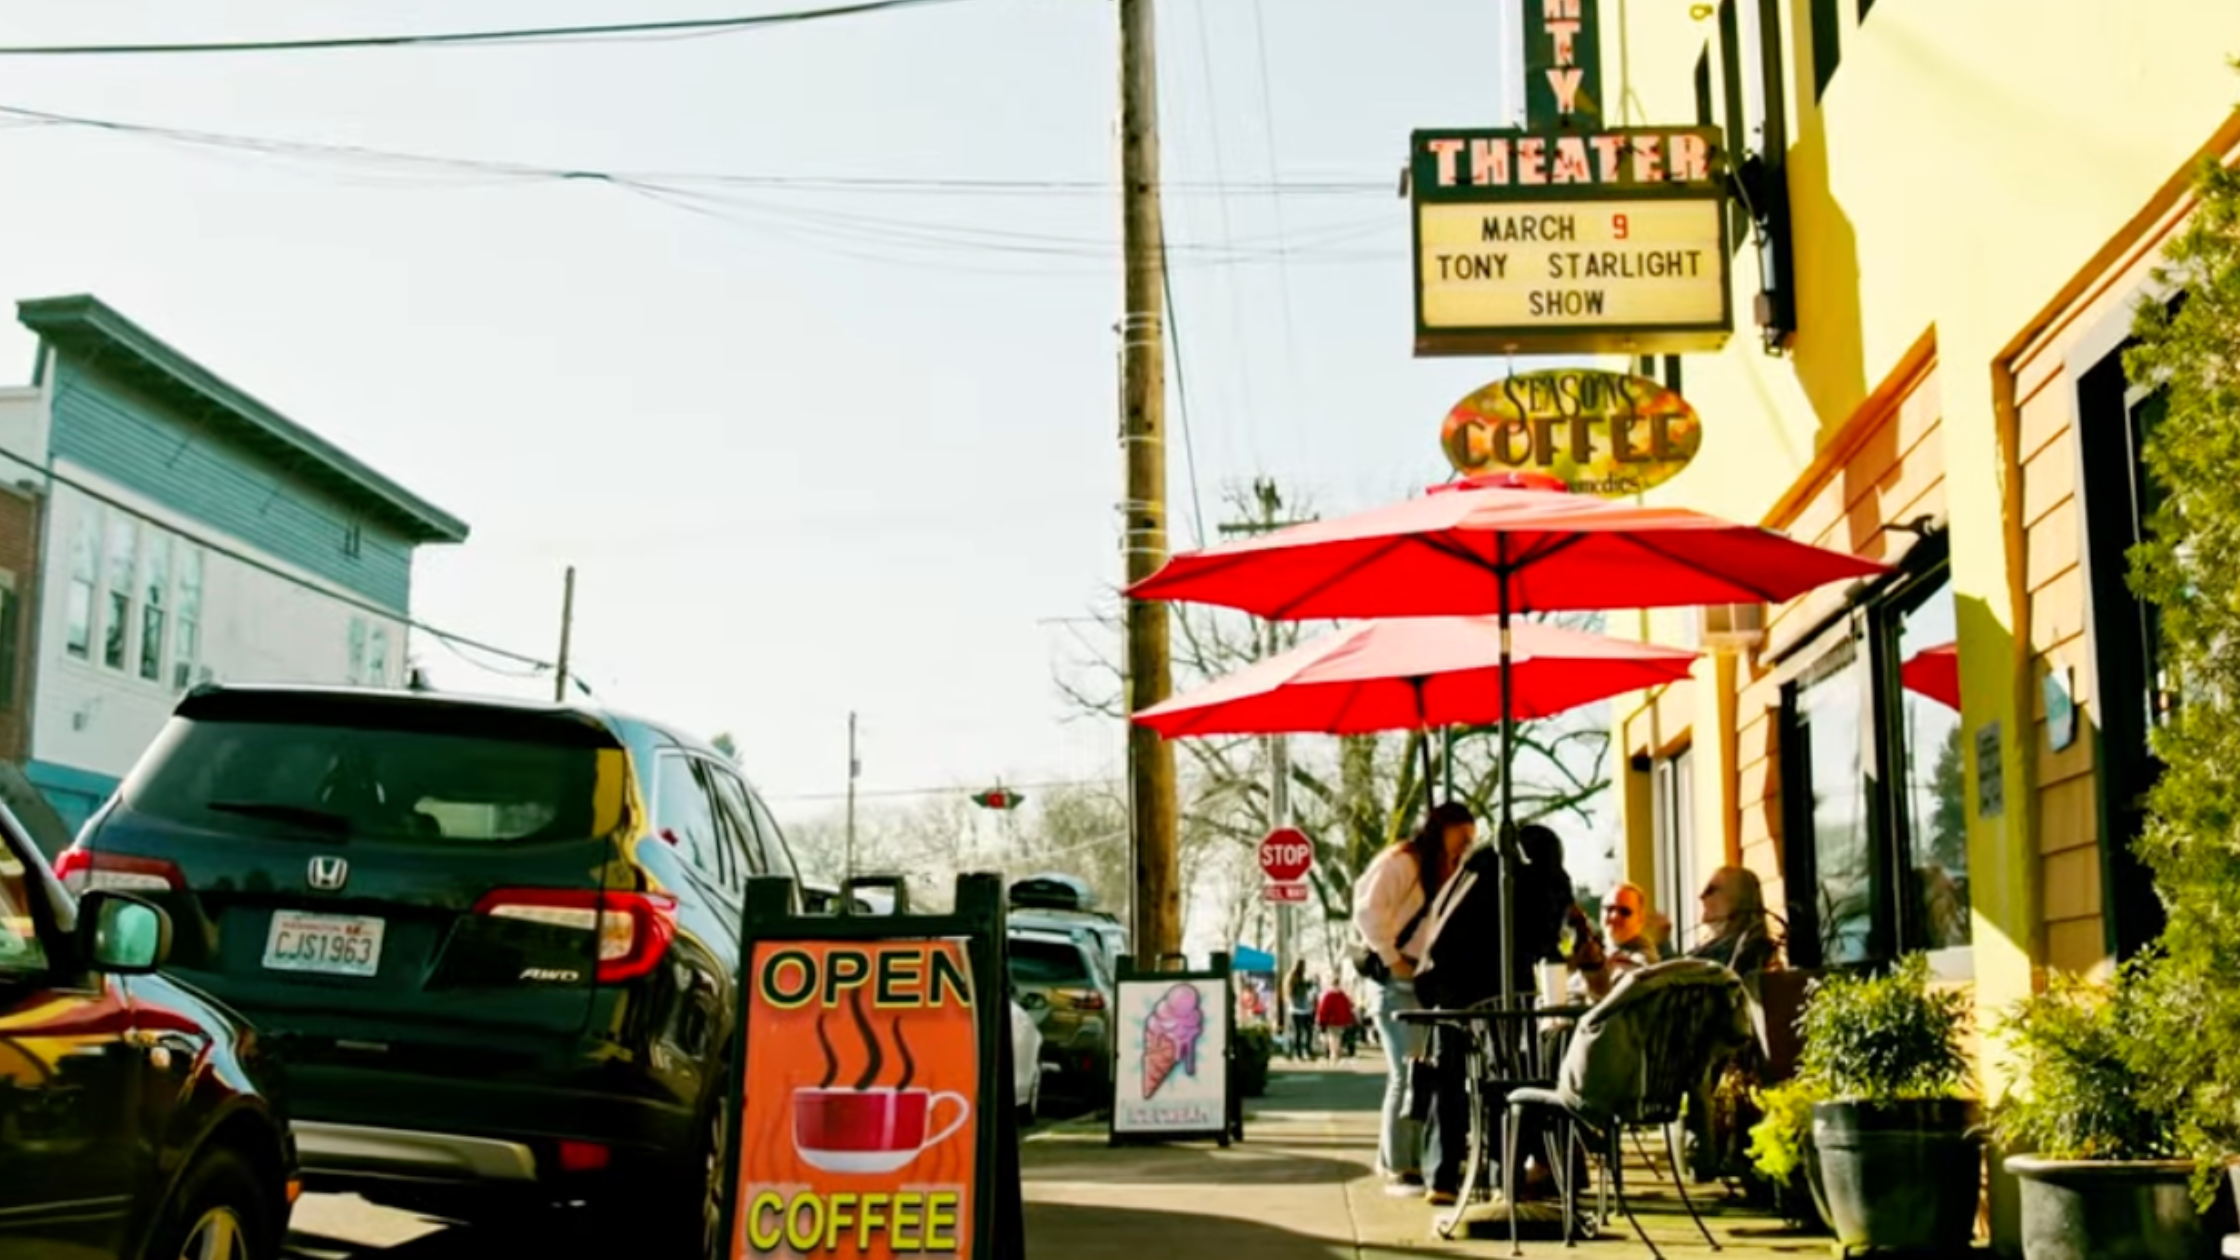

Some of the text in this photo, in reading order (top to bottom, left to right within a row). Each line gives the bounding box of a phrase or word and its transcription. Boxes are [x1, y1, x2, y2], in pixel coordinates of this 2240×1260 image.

[1429, 133, 1711, 187] THEATER
[1481, 213, 1629, 242] MARCH 9
[1436, 250, 1703, 281] TONY STARLIGHT
[1528, 290, 1604, 316] SHOW
[1503, 374, 1637, 435] SEASONS
[1452, 411, 1692, 469] COFFEE
[1262, 844, 1309, 866] STOP
[275, 931, 372, 964] CJS1963
[519, 967, 579, 981] AWD
[758, 945, 974, 1009] OPEN
[748, 1190, 959, 1252] COFFEE
